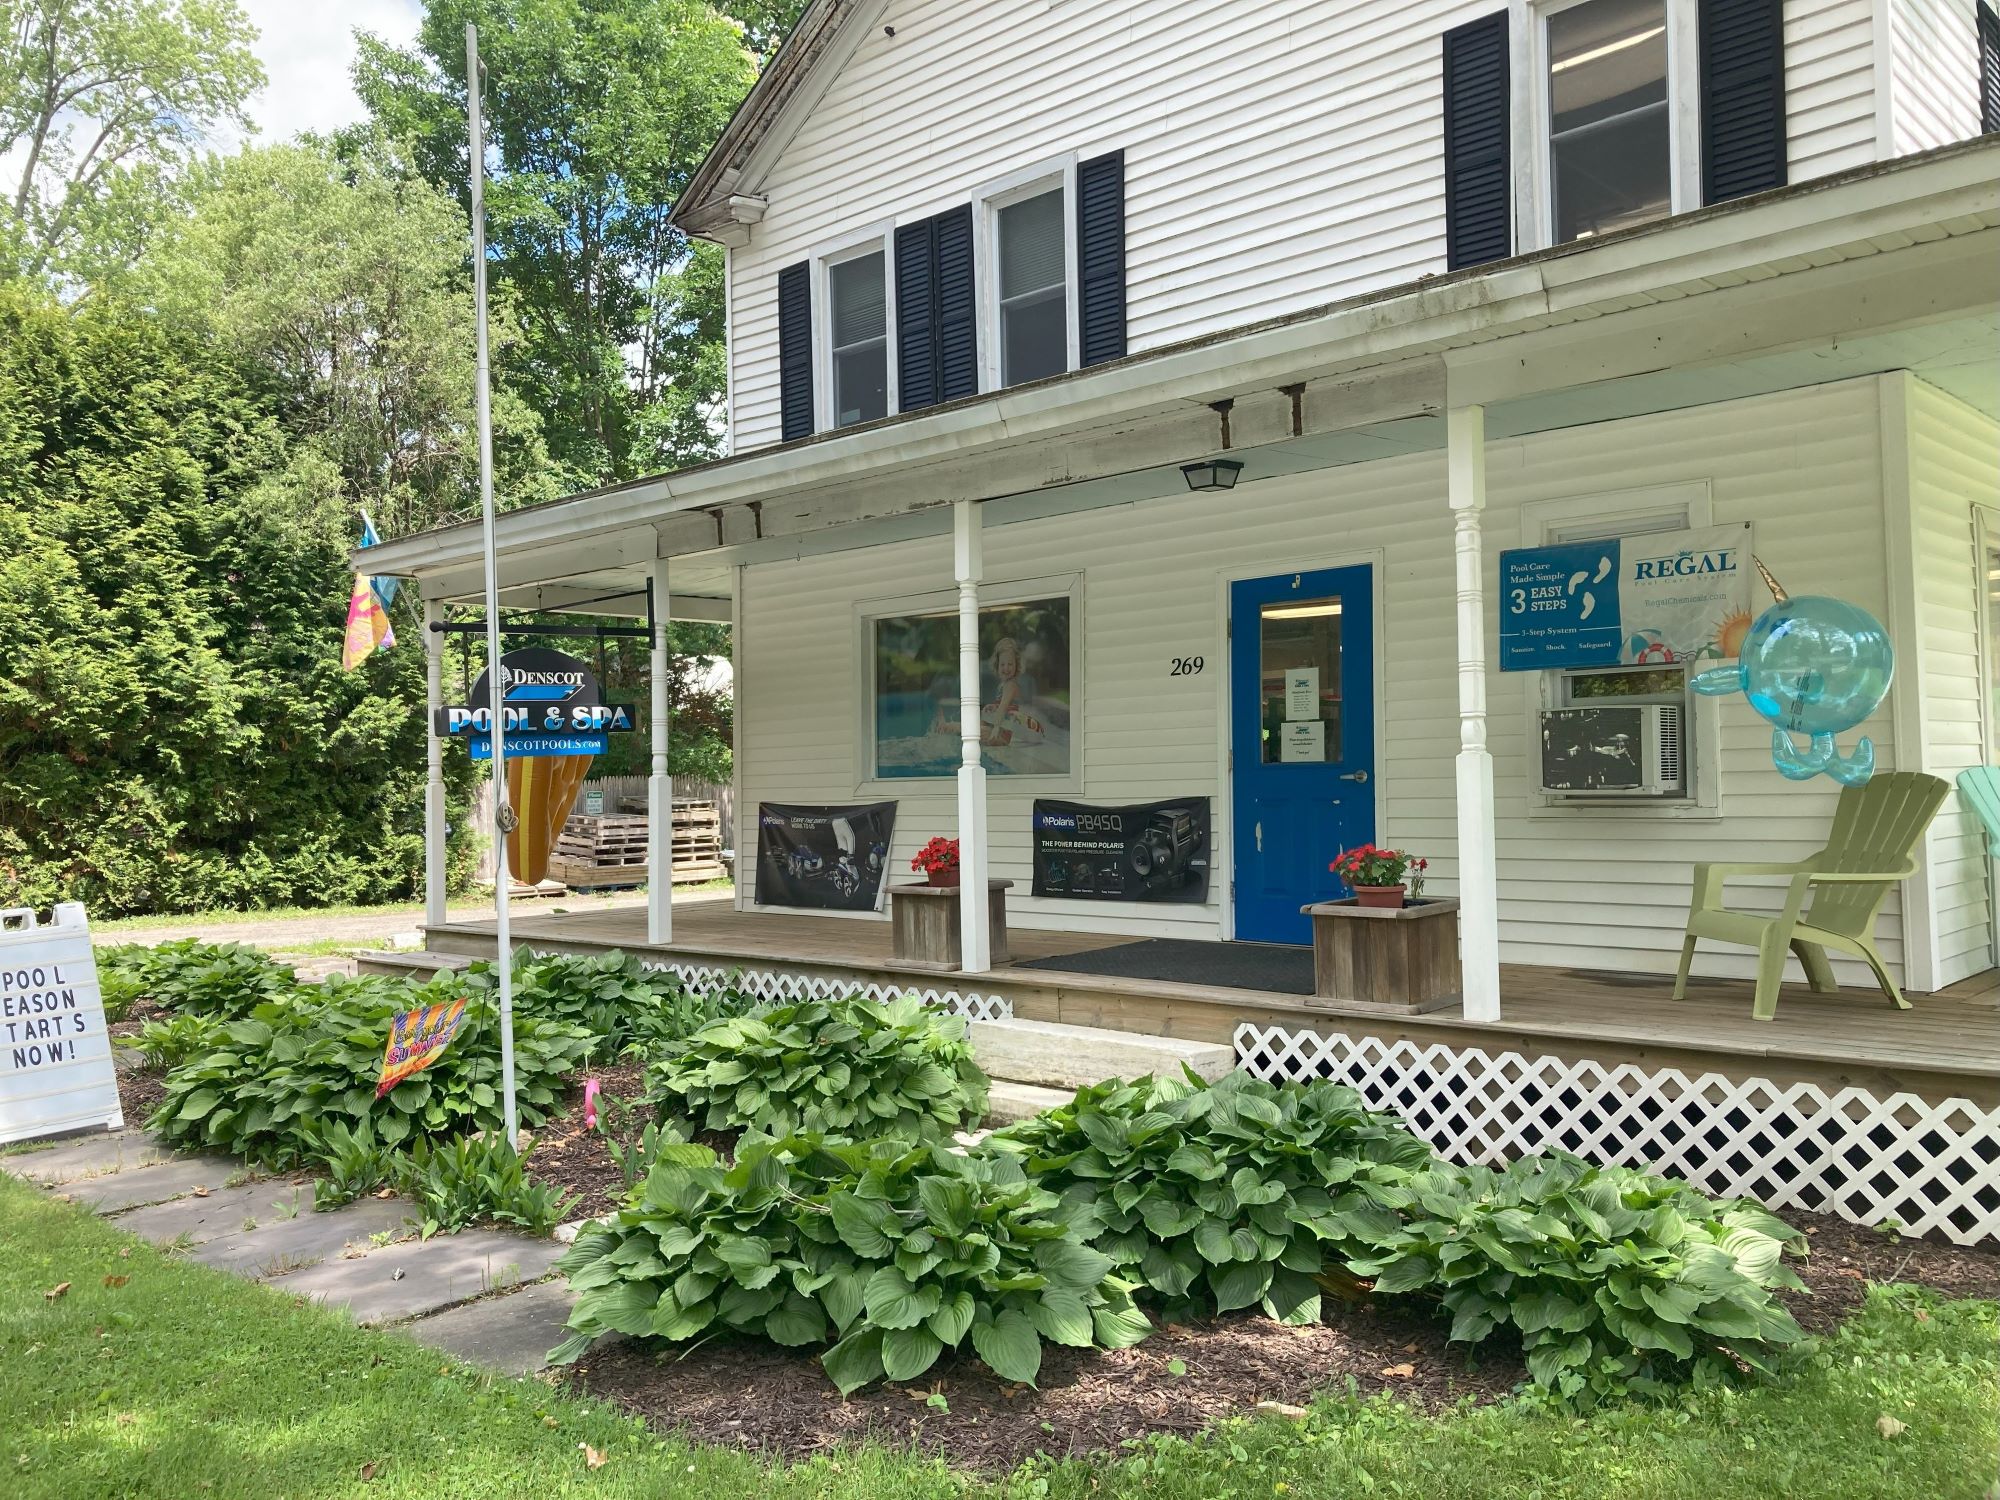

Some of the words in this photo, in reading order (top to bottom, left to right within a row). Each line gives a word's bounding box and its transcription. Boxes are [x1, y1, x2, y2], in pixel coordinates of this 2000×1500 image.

[1510, 564, 1528, 573] Pool
[1529, 562, 1551, 571] Care
[1634, 552, 1737, 580] REGAL
[1510, 575, 1534, 584] Made
[1535, 571, 1565, 582] Simple
[1511, 588, 1526, 614] 3
[1531, 585, 1562, 599] EASY
[1531, 599, 1567, 612] STEPS
[1521, 628, 1546, 637] 3-Step
[1547, 627, 1577, 637] System
[1170, 656, 1204, 676] 269
[449, 707, 538, 733] POOL
[544, 706, 566, 731] &
[571, 706, 632, 730] SPA
[1048, 816, 1075, 827] Polaris
[1076, 814, 1123, 833] PB4SQ
[13, 1040, 75, 1068] NOW!
